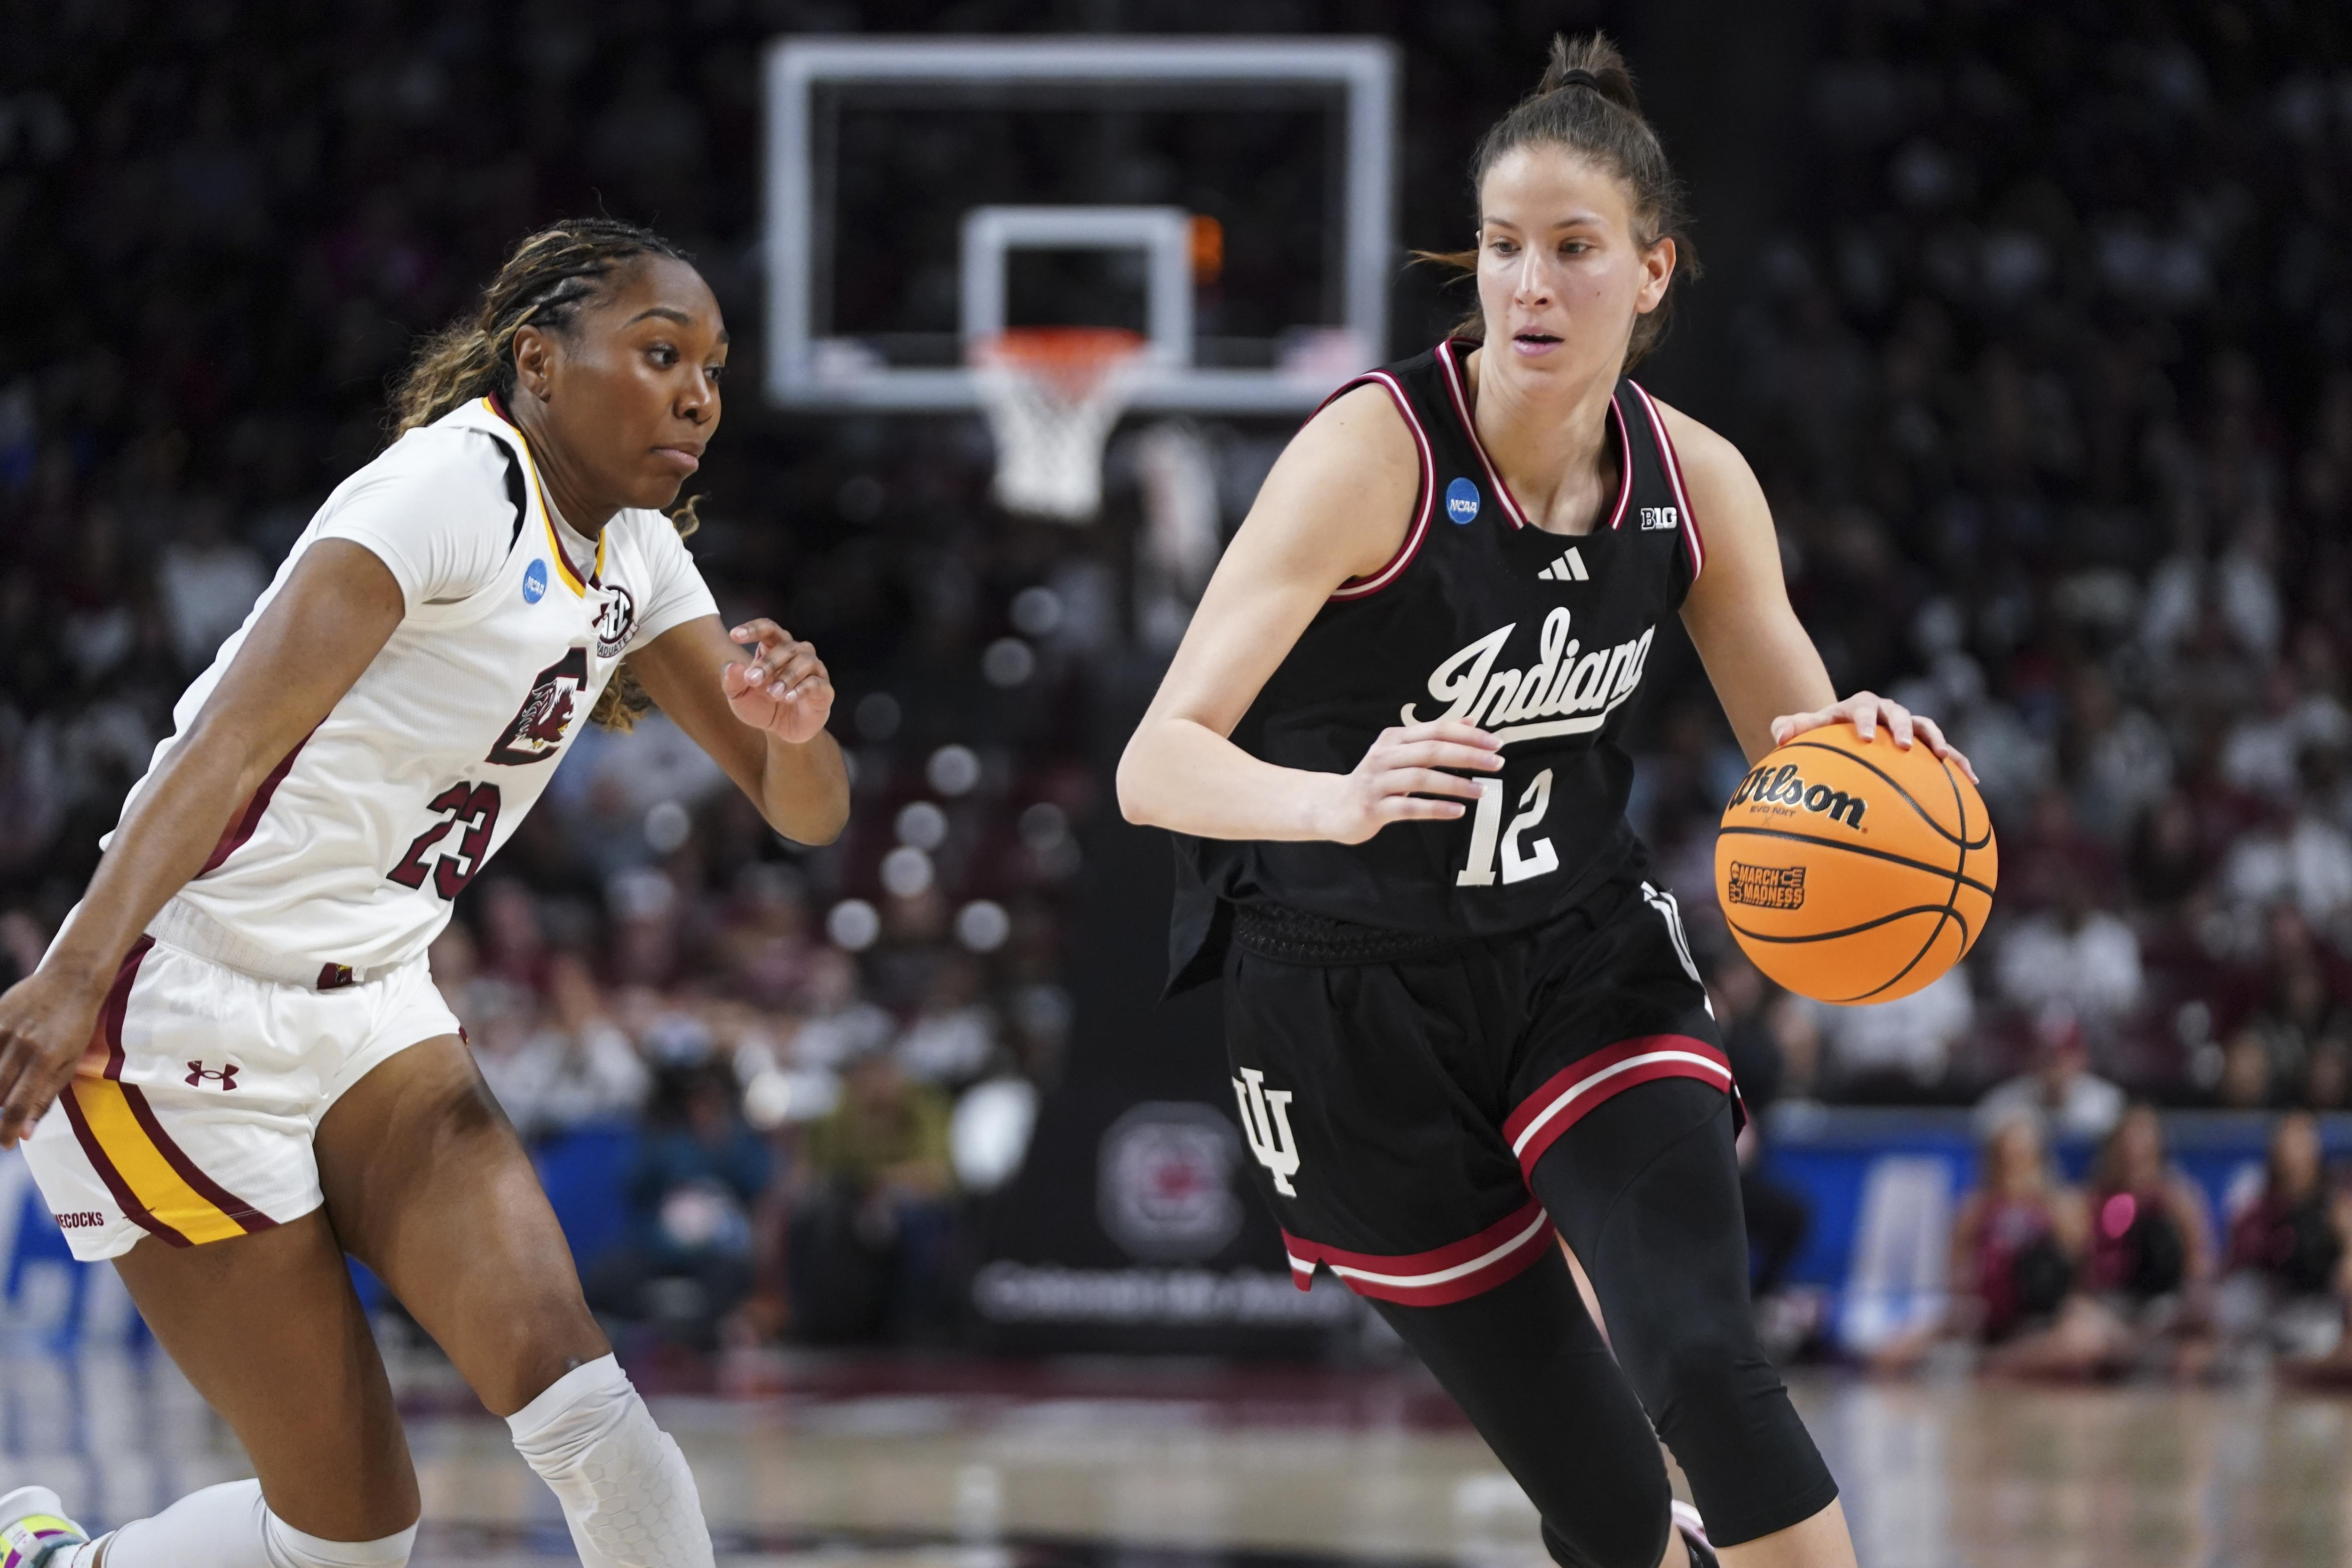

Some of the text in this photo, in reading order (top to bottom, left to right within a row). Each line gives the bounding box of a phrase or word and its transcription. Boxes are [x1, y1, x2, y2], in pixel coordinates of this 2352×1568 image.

[1450, 499, 1477, 513] NCAA
[1400, 607, 1656, 727] Indiana
[386, 781, 501, 902] 23
[1456, 768, 1559, 886] 12
[1740, 865, 1780, 886] MARCH
[1744, 883, 1804, 905] MADNESS
